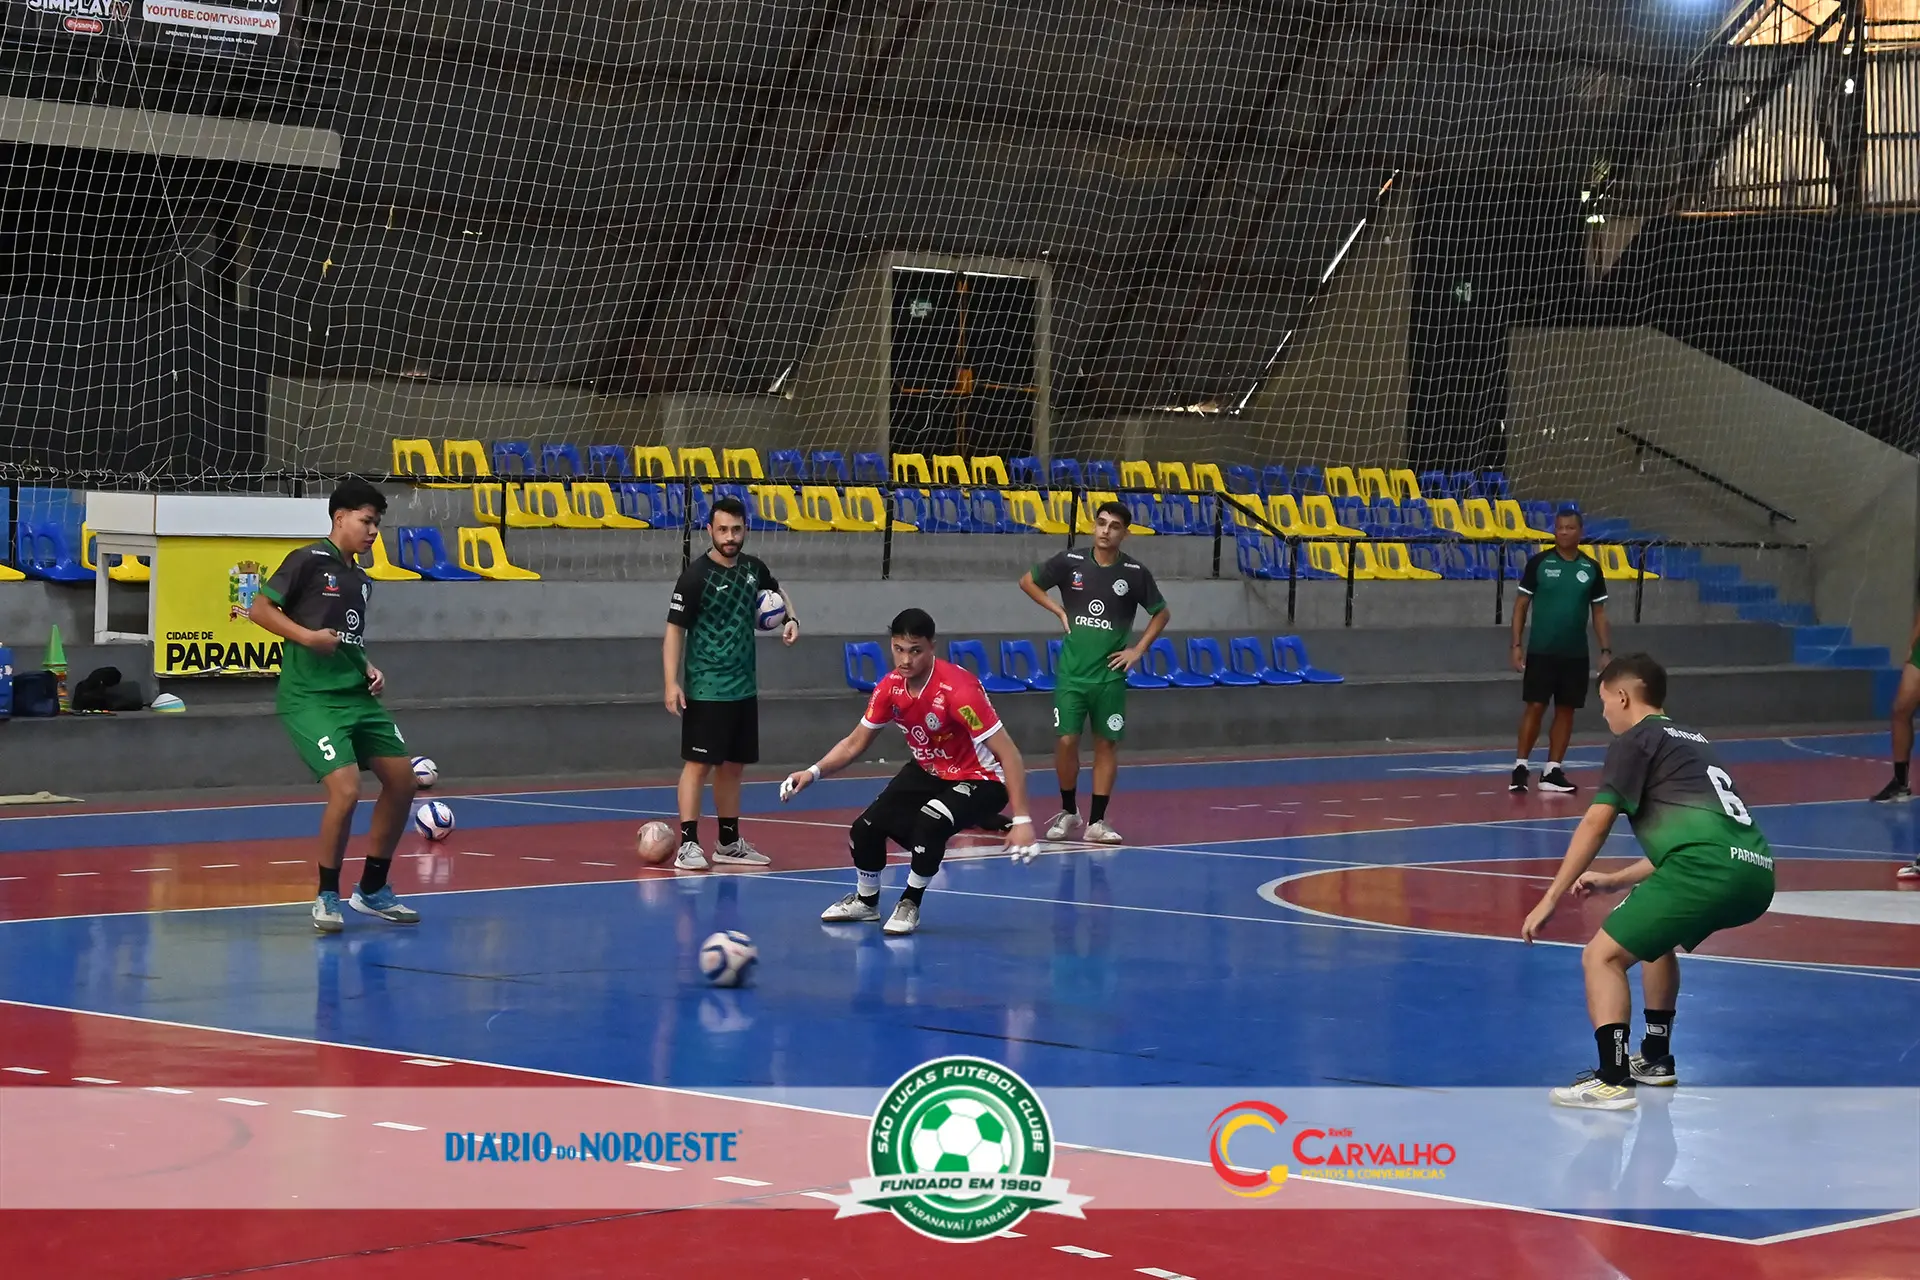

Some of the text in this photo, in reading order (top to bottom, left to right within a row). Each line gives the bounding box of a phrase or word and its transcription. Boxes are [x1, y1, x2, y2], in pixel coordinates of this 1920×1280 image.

[146, 4, 277, 29] YOUTUBE.COM/TVSIMPLAY
[1075, 615, 1113, 631] CRESOL
[166, 631, 213, 641] CIDADE DE
[166, 641, 283, 671] PARANA
[317, 735, 337, 761] 5
[1706, 764, 1752, 826] 6
